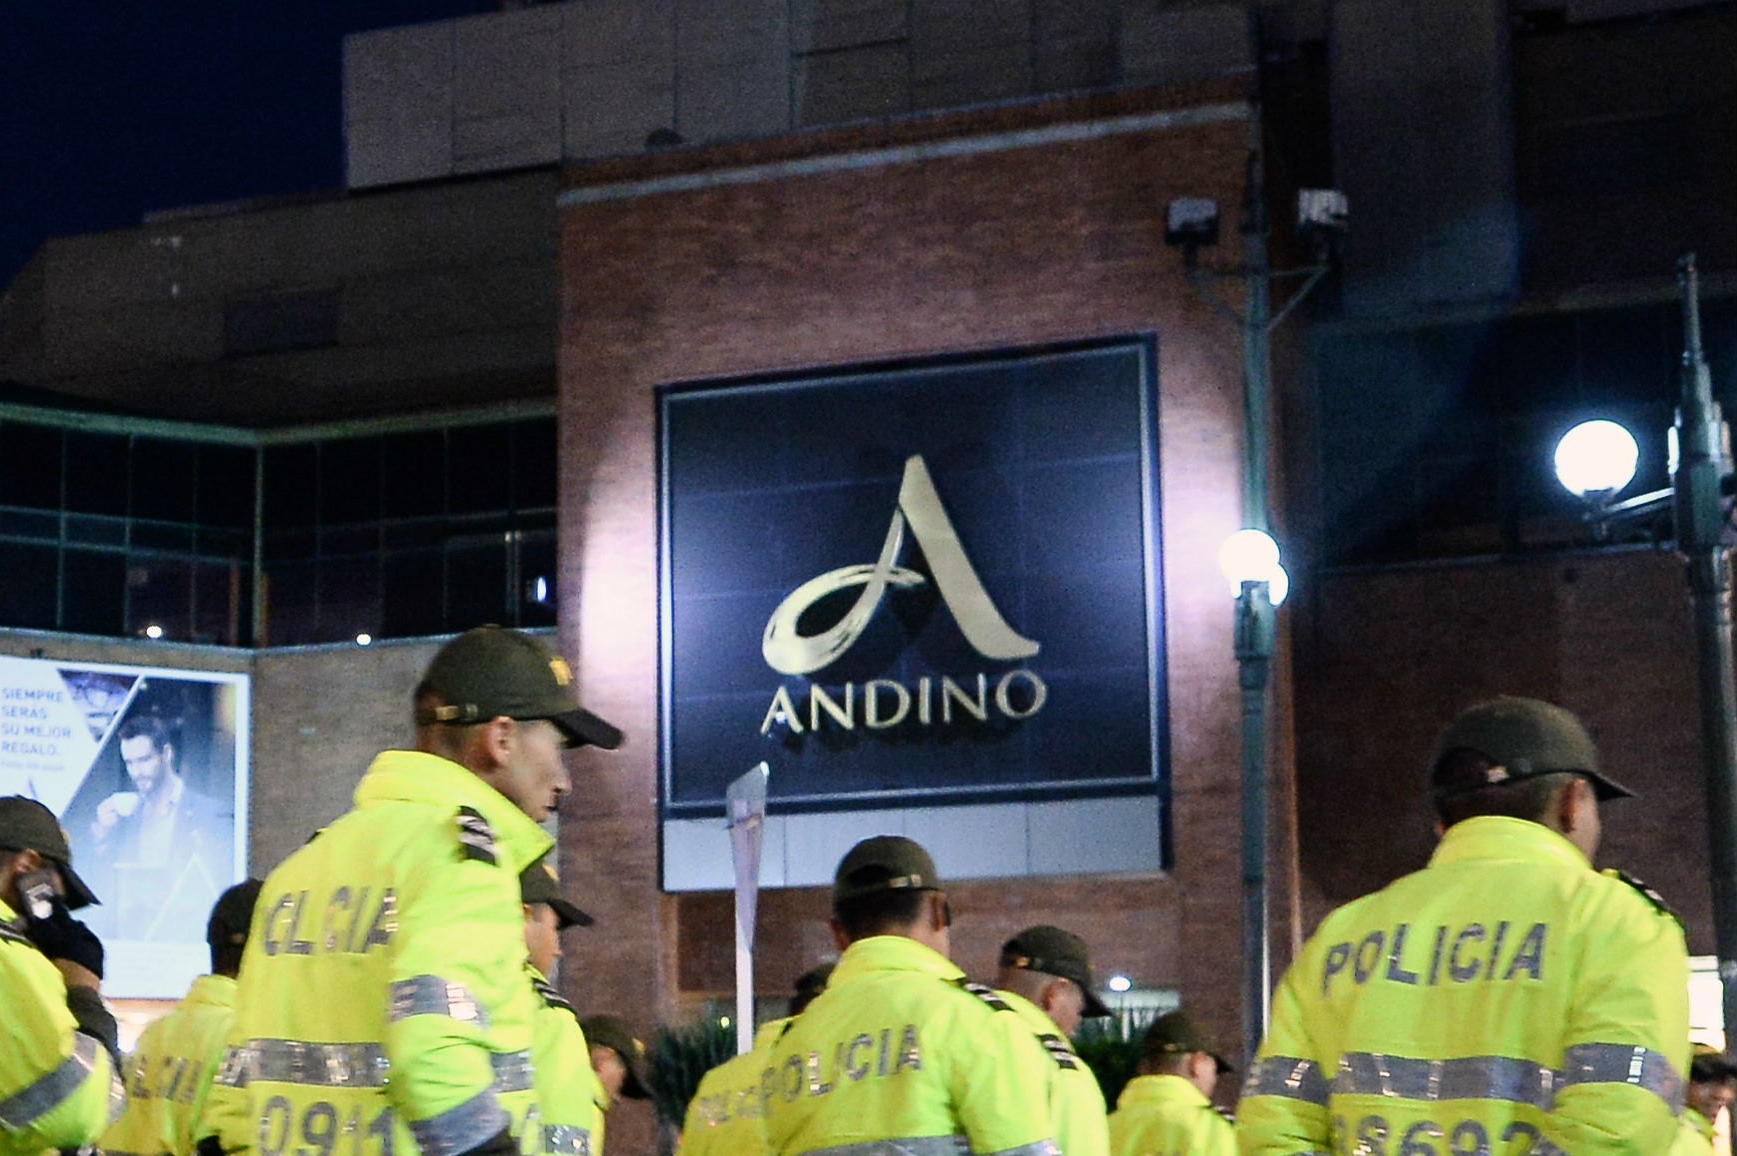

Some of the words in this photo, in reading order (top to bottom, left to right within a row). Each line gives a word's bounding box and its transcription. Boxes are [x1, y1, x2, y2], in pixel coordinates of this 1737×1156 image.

[2, 688, 64, 703] SIEMPRE
[761, 669, 1048, 735] ANDINO
[2, 722, 20, 735] SU
[24, 726, 71, 738] MEJOR
[1321, 920, 1548, 998] POLICIA
[761, 1023, 924, 1118] POLICIA
